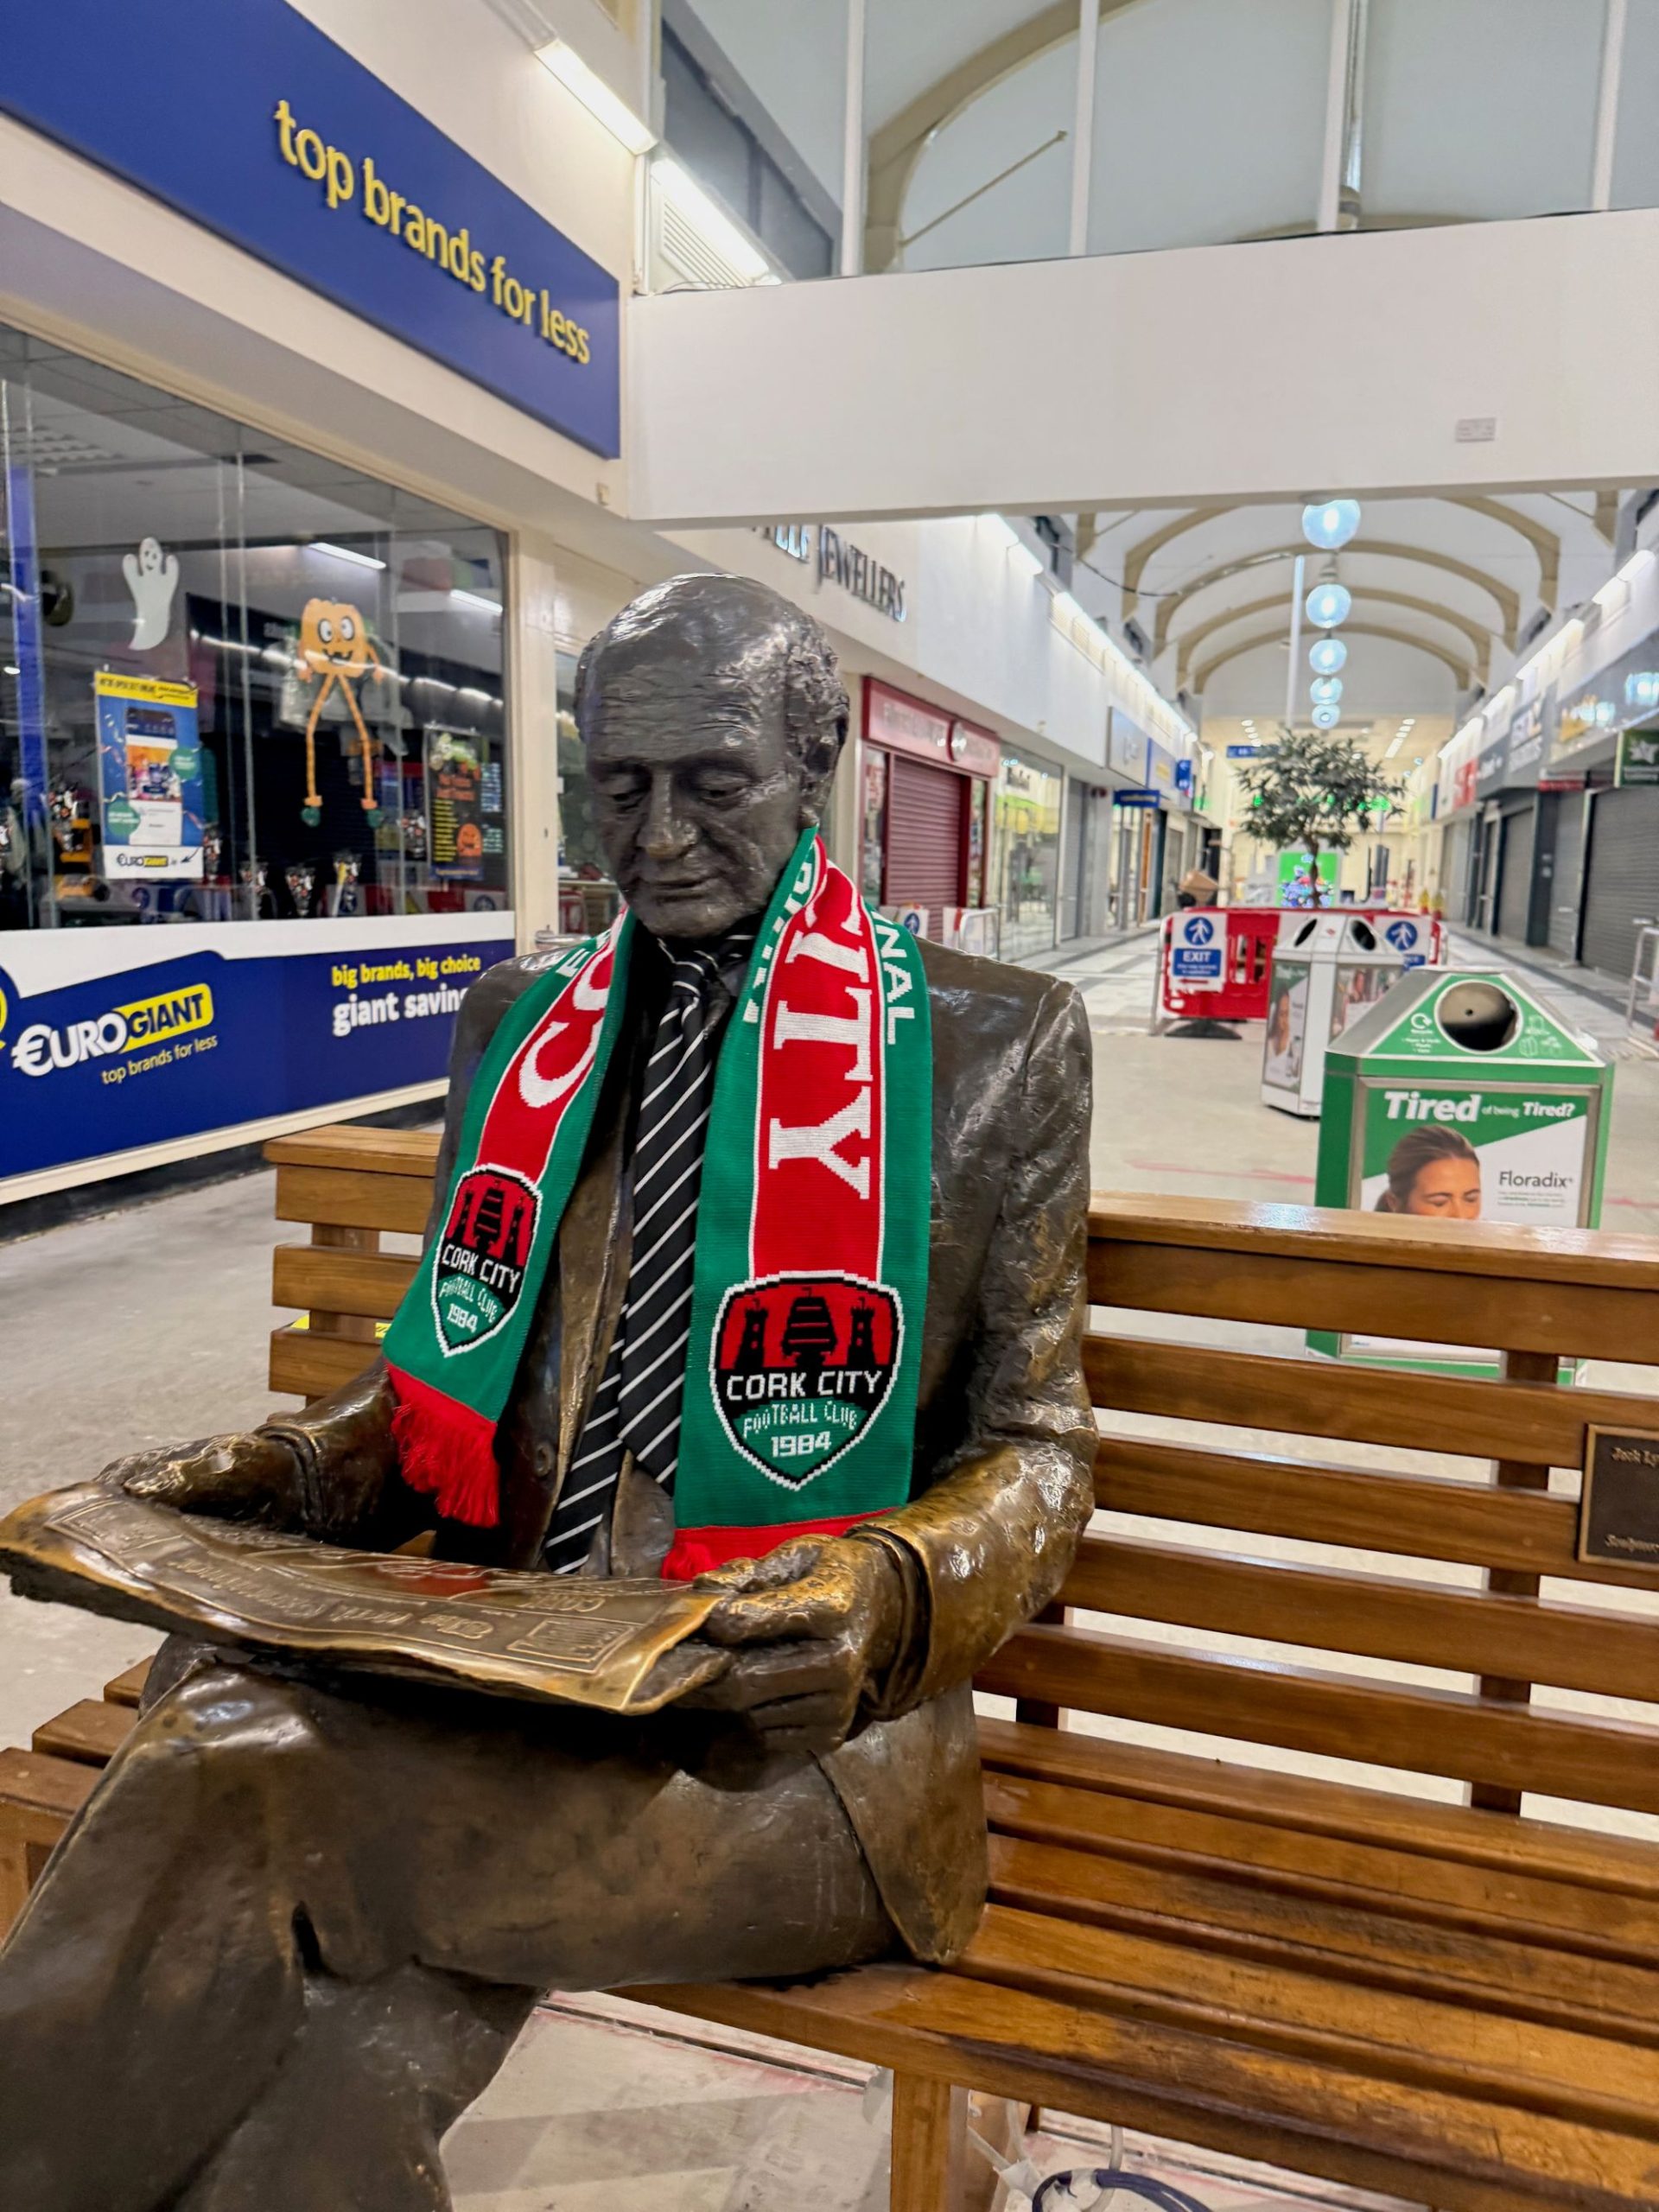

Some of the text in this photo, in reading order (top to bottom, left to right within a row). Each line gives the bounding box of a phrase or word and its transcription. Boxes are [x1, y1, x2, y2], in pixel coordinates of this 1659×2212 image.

[274, 99, 591, 365] top brands for less
[817, 524, 907, 622] JEWELLERS
[332, 954, 481, 989] big brands, big choice
[1183, 950, 1211, 963] EXIT
[333, 994, 400, 1037] giant
[768, 859, 873, 1199] CITY
[101, 1035, 218, 1085] top brands for less
[1384, 1090, 1482, 1122] Tired
[1482, 1104, 1493, 1116] of
[1522, 1101, 1576, 1118] Tired?
[442, 1244, 521, 1294] CORK CITY
[447, 1302, 479, 1333] 1984
[726, 1370, 882, 1401] CORK CITY
[771, 1431, 832, 1458] 1984
